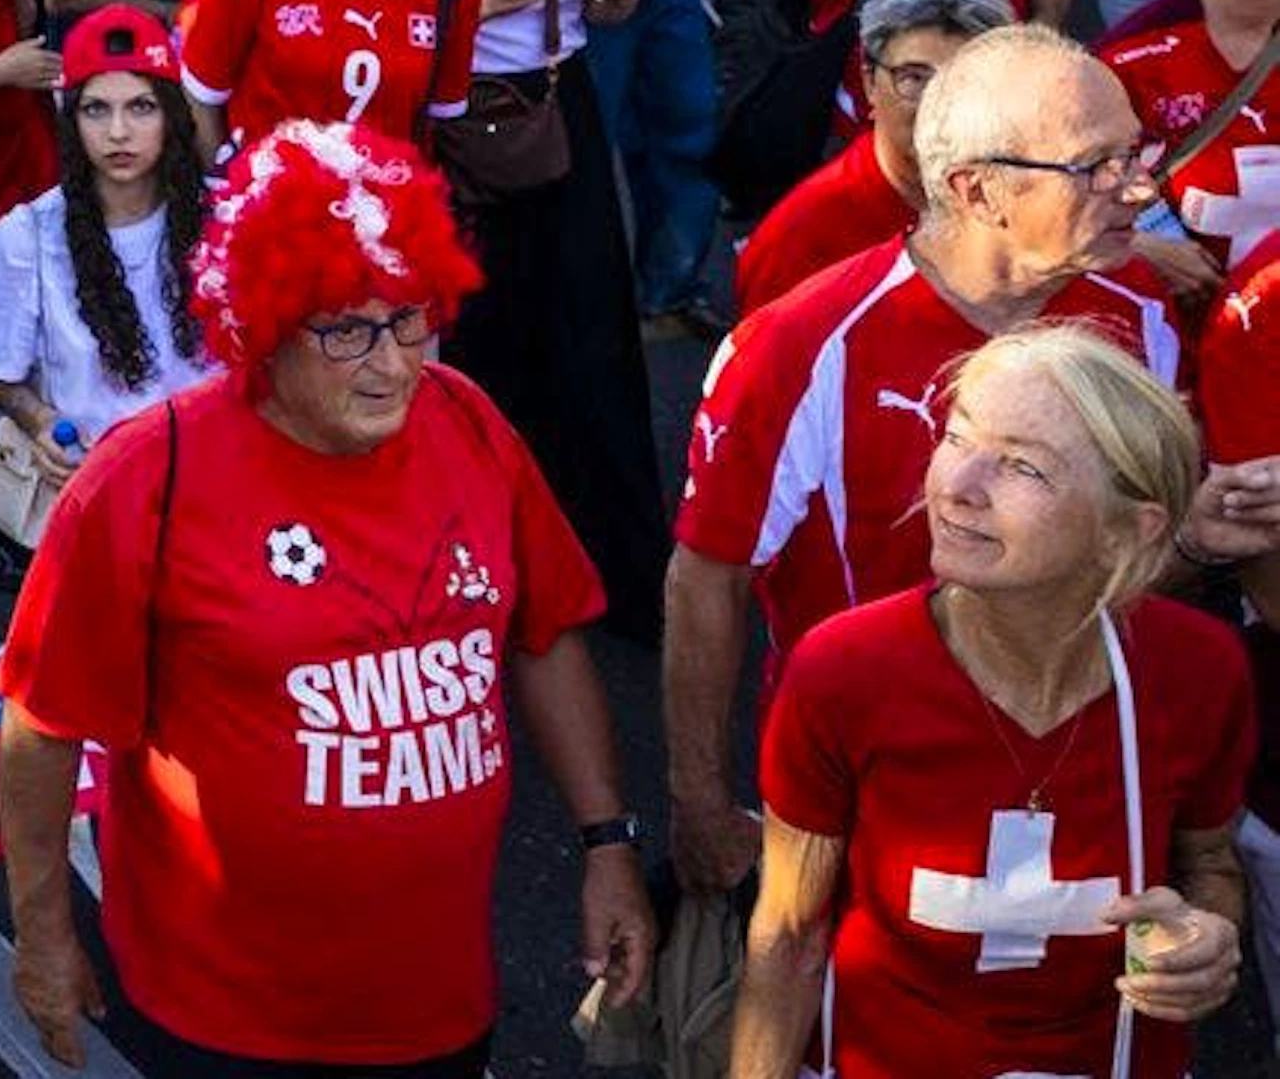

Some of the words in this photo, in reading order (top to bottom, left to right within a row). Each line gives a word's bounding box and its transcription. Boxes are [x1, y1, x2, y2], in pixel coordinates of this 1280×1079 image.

[342, 49, 381, 123] 9
[286, 628, 496, 733] SWISS
[295, 711, 485, 809] TEAM
